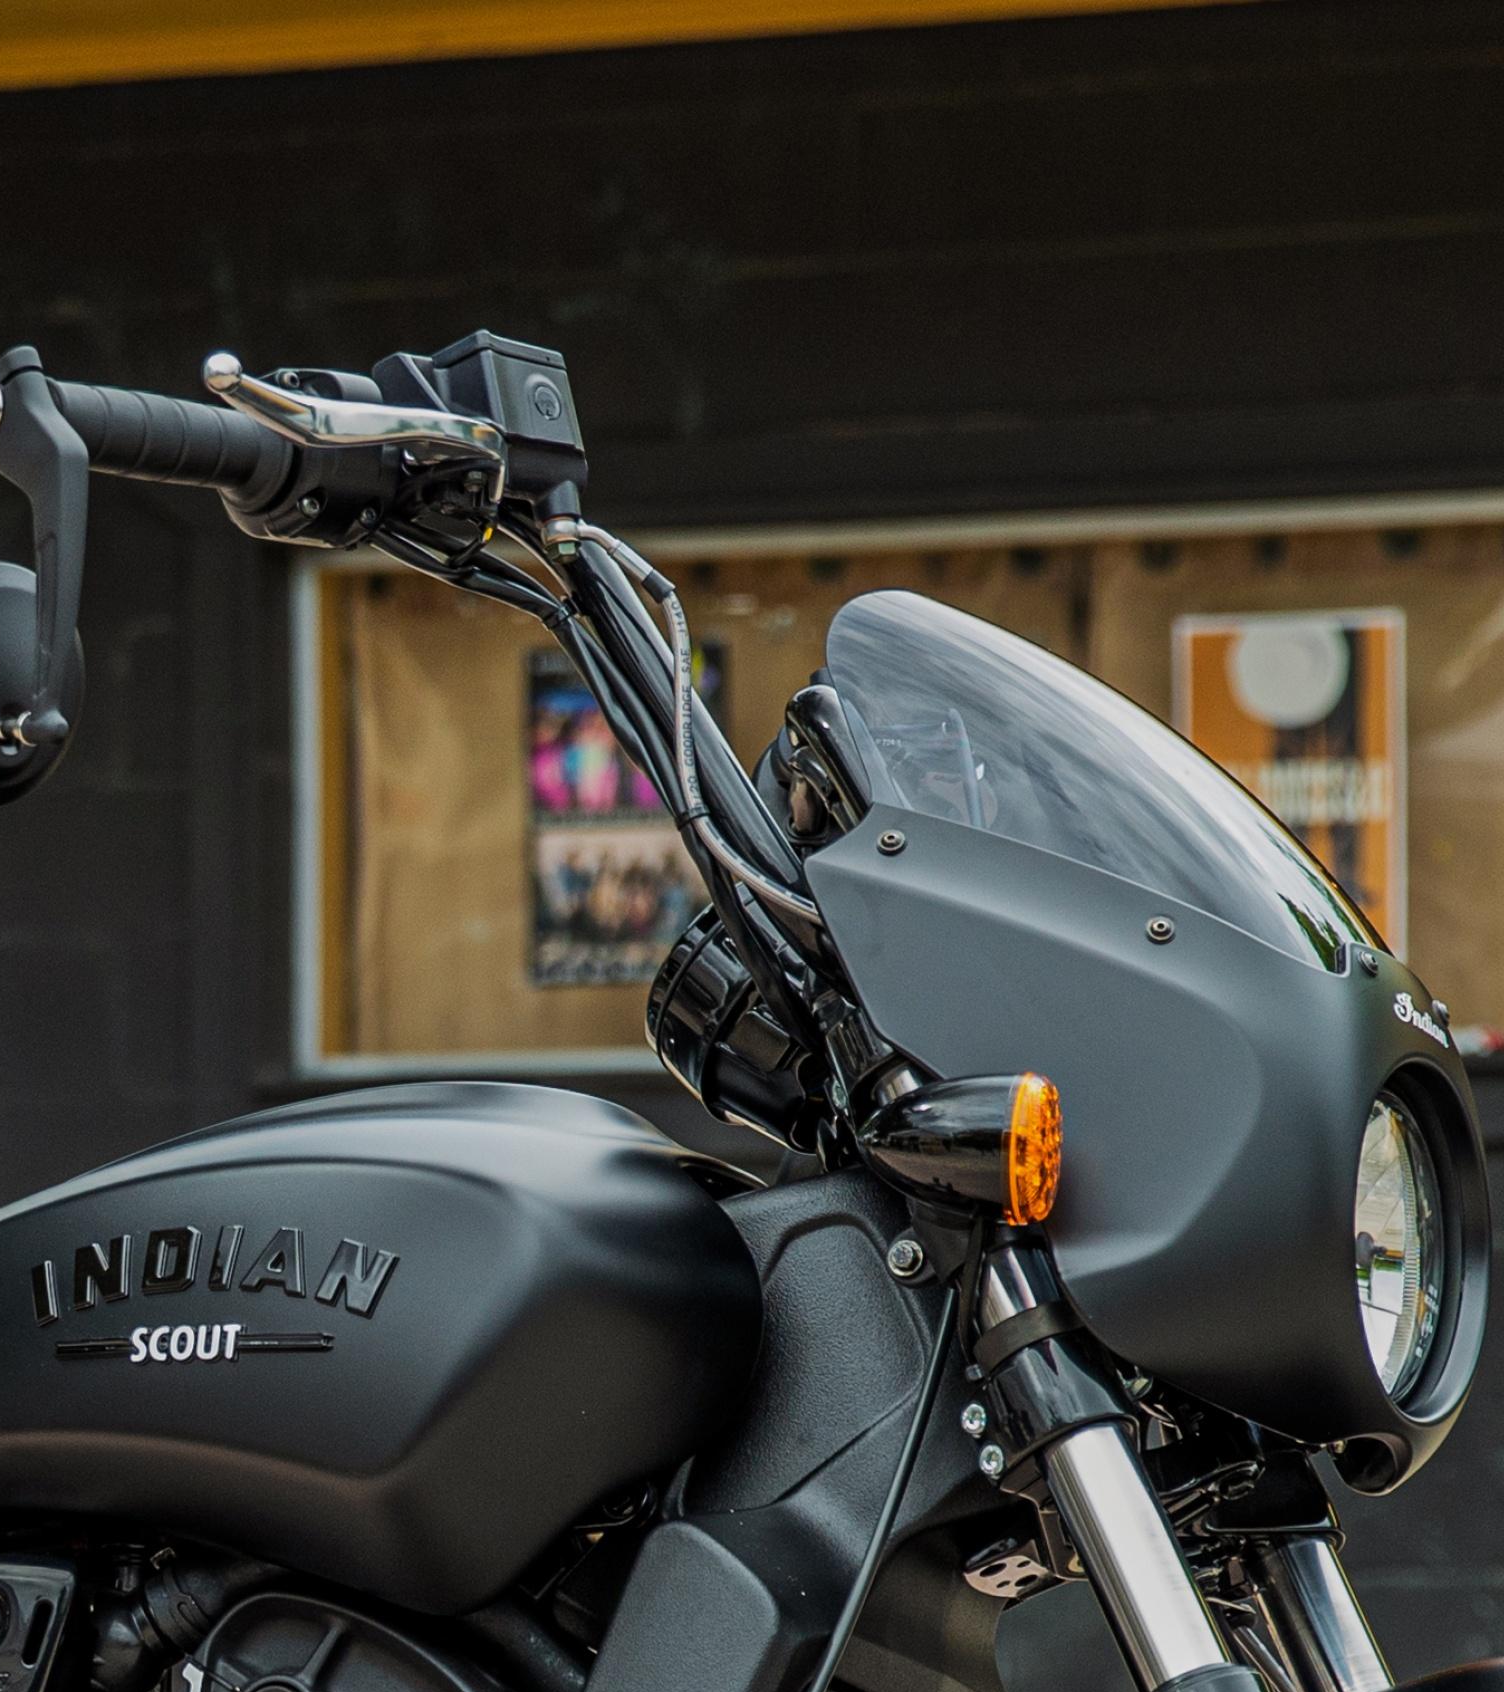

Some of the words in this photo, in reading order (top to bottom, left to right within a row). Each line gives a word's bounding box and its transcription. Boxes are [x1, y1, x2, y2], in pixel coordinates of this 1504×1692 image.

[681, 648, 691, 673] SAE
[682, 685, 695, 766] GOODRIDGE
[1393, 991, 1450, 1049] Indian
[30, 1224, 400, 1327] INDIAN
[129, 1323, 242, 1362] SCOUT
